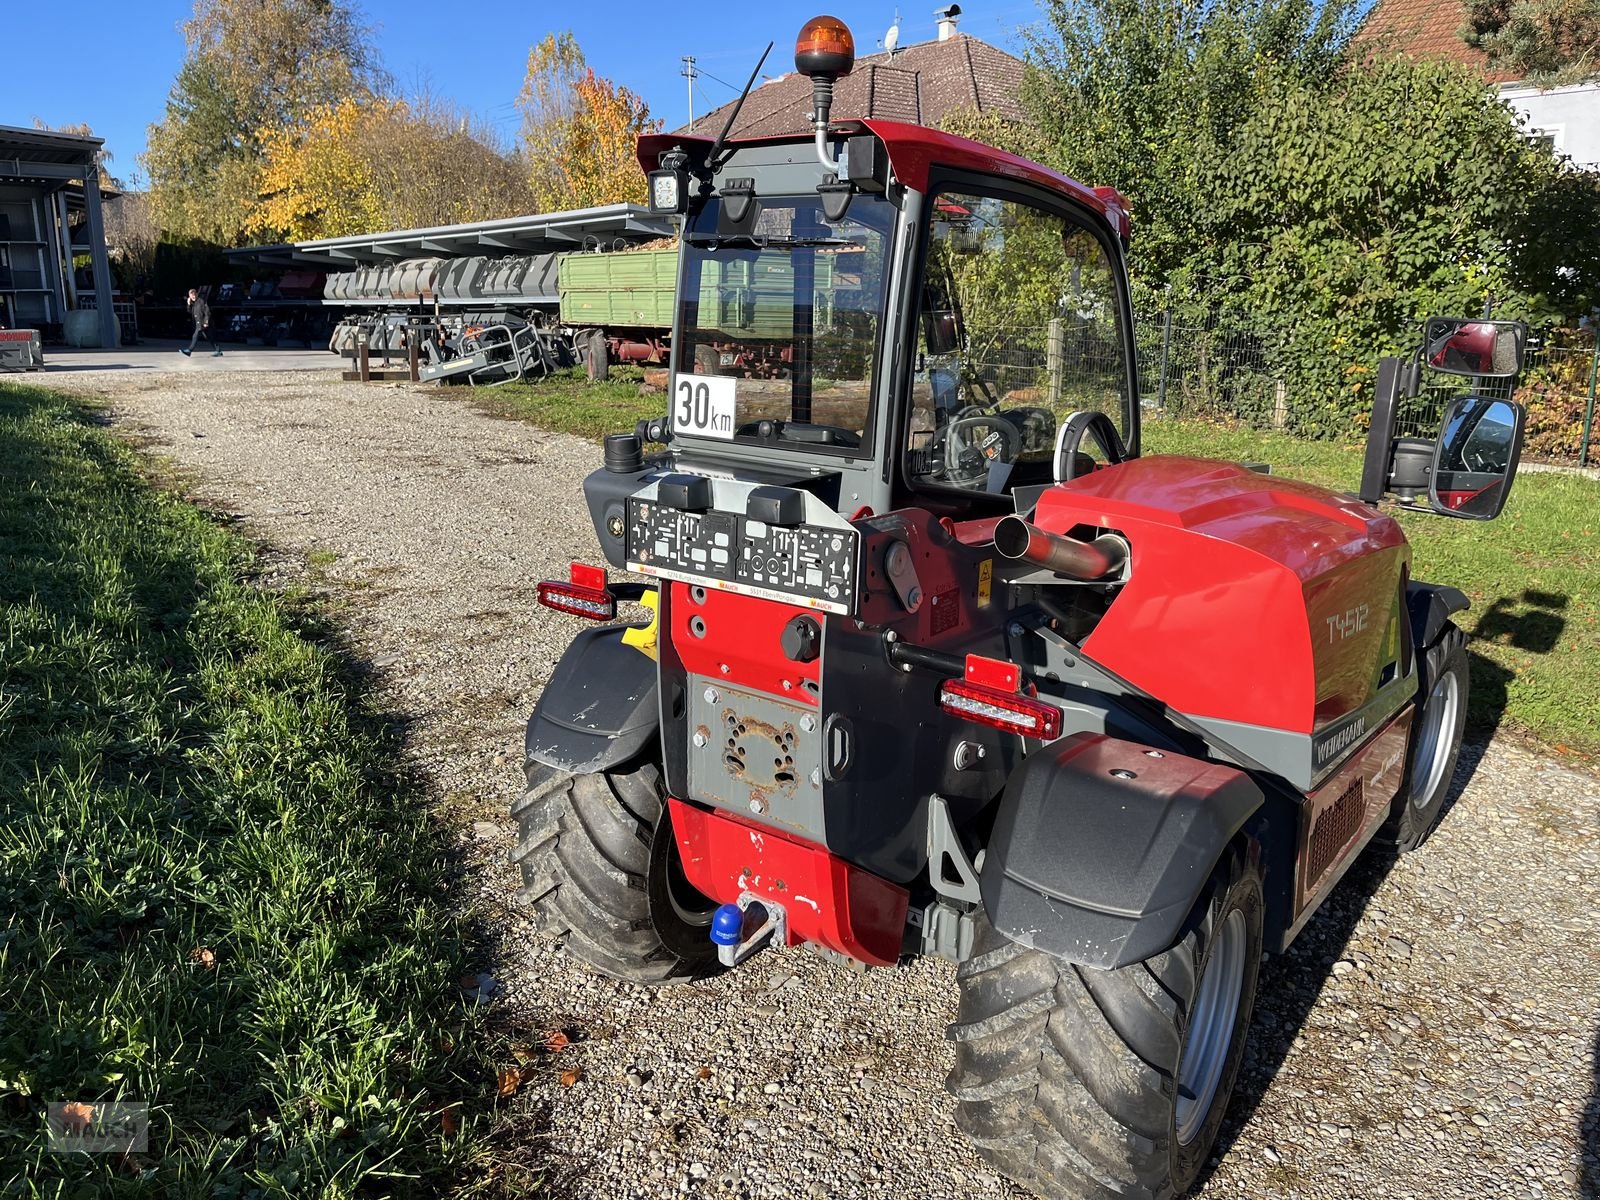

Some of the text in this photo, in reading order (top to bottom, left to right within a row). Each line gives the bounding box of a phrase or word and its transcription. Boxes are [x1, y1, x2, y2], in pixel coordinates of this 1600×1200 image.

[677, 380, 731, 432] 30 km
[810, 599, 832, 611] MAUCH
[1326, 603, 1369, 645] T4512
